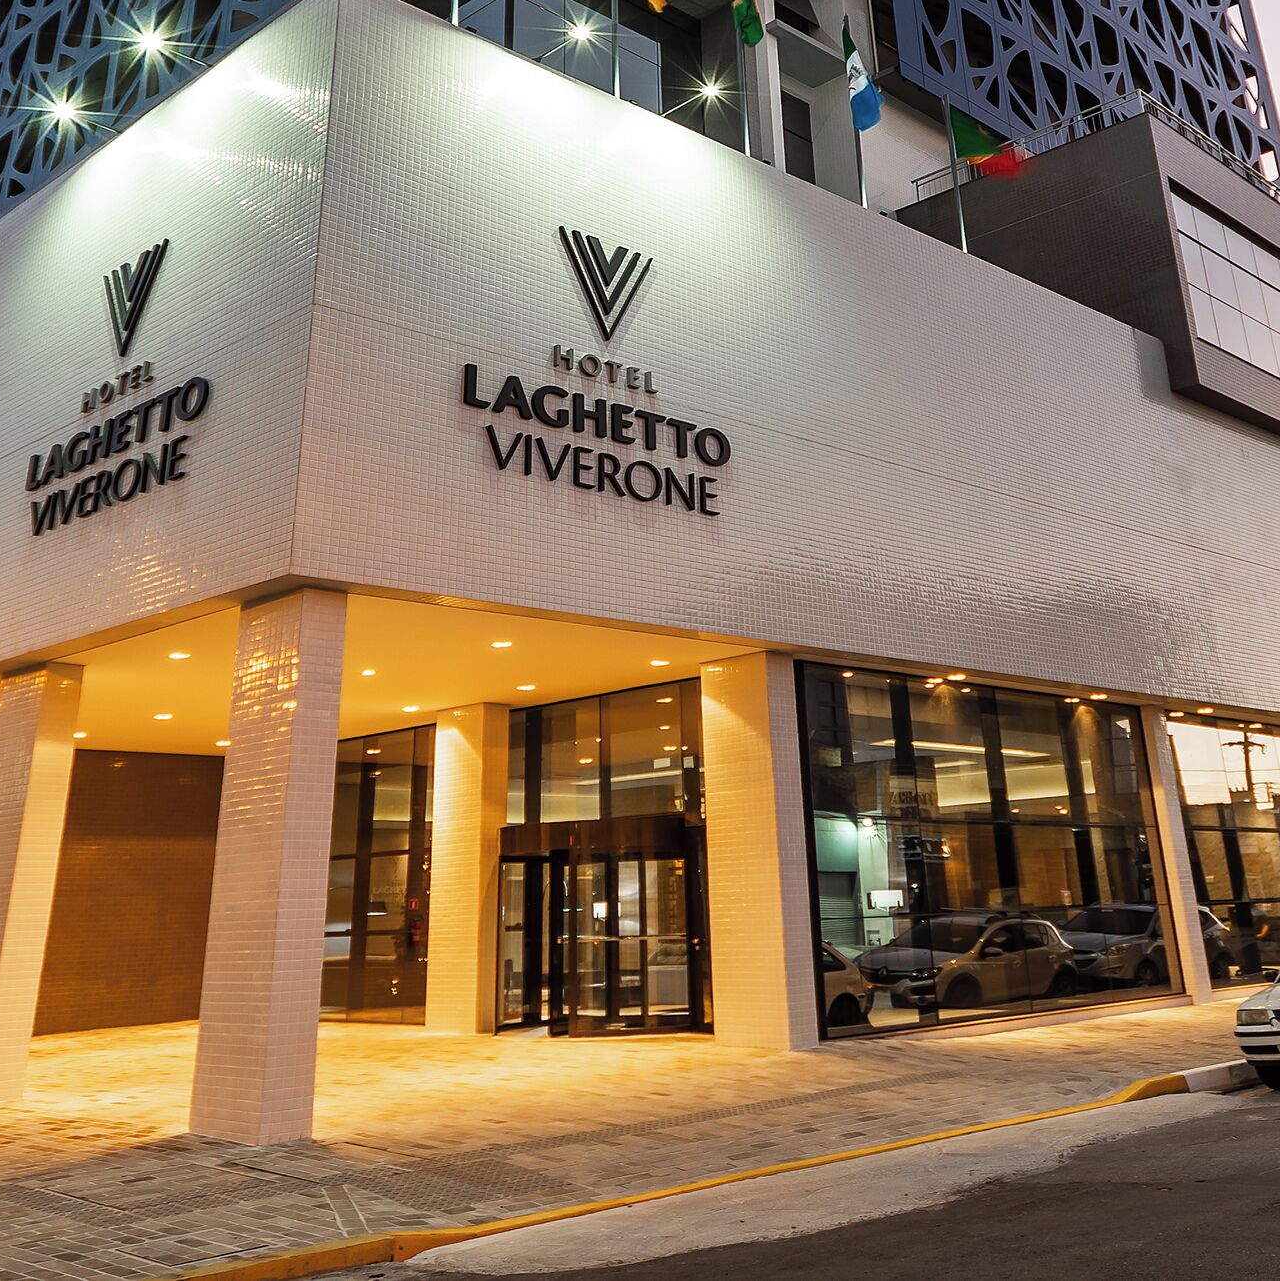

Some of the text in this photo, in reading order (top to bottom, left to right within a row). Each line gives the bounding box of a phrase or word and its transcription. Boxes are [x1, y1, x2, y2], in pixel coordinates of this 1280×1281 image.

[80, 360, 154, 413] HOTEL
[463, 362, 732, 467] LAGHETTO
[553, 344, 659, 394] HOTEL
[24, 376, 210, 491] LAGHETTO
[485, 424, 721, 517] VIVERONE
[30, 434, 191, 536] VIVERONE
